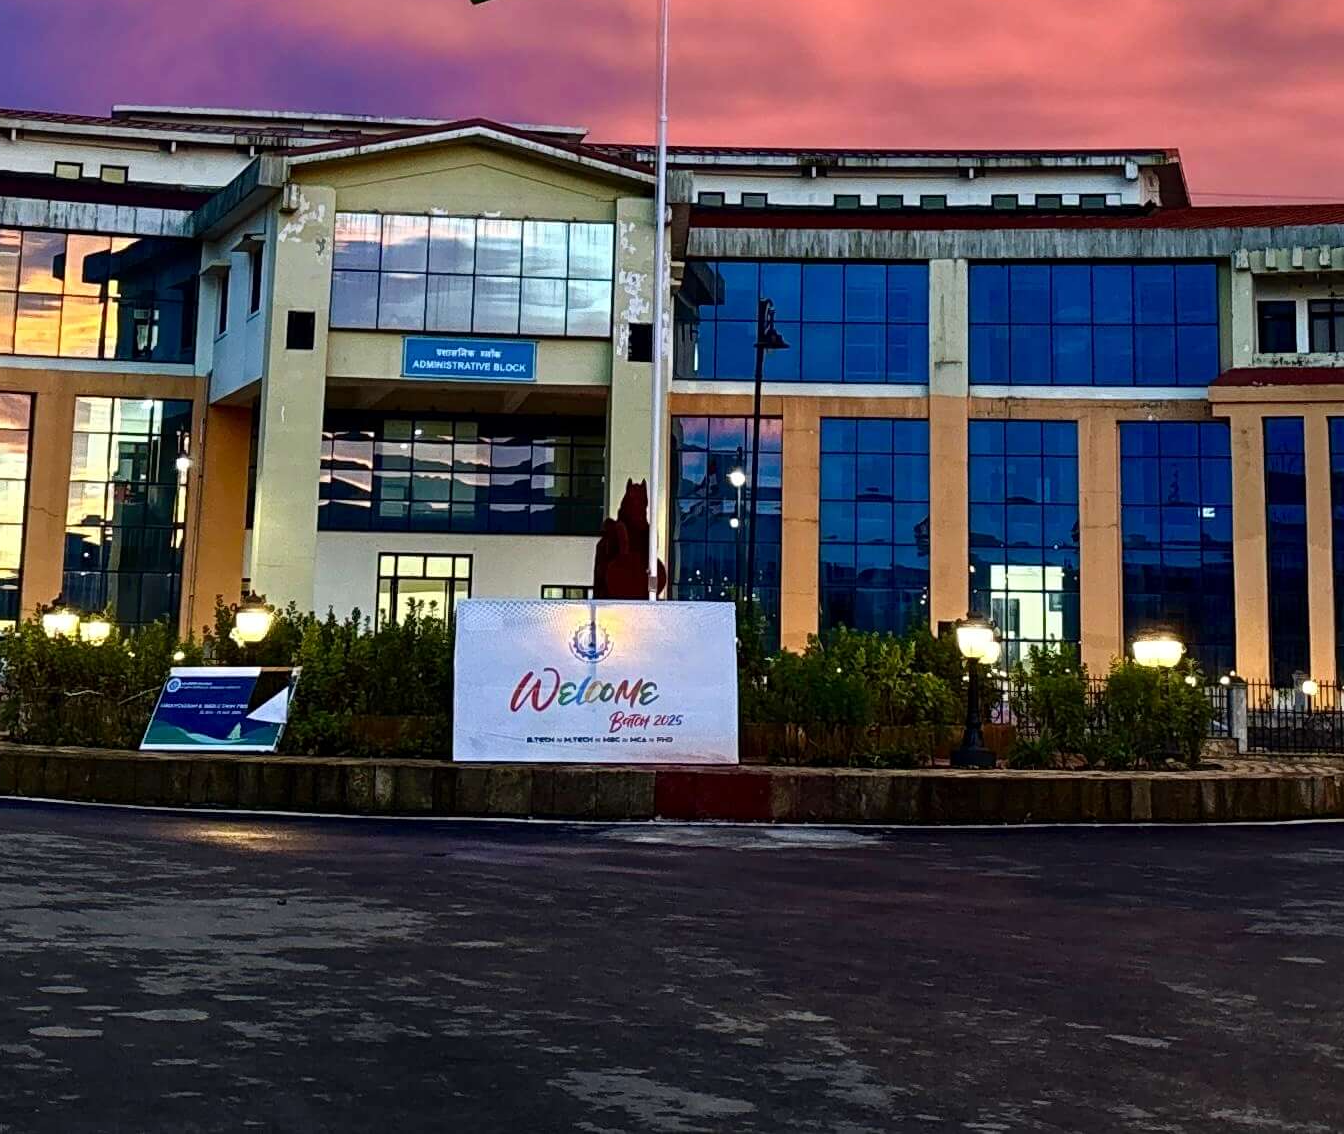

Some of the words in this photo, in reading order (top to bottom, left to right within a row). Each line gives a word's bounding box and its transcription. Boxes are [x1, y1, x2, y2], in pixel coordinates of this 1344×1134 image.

[412, 360, 491, 371] ADMINISTRATIVE
[493, 362, 526, 372] BLOCK
[653, 714, 684, 726] 2025
